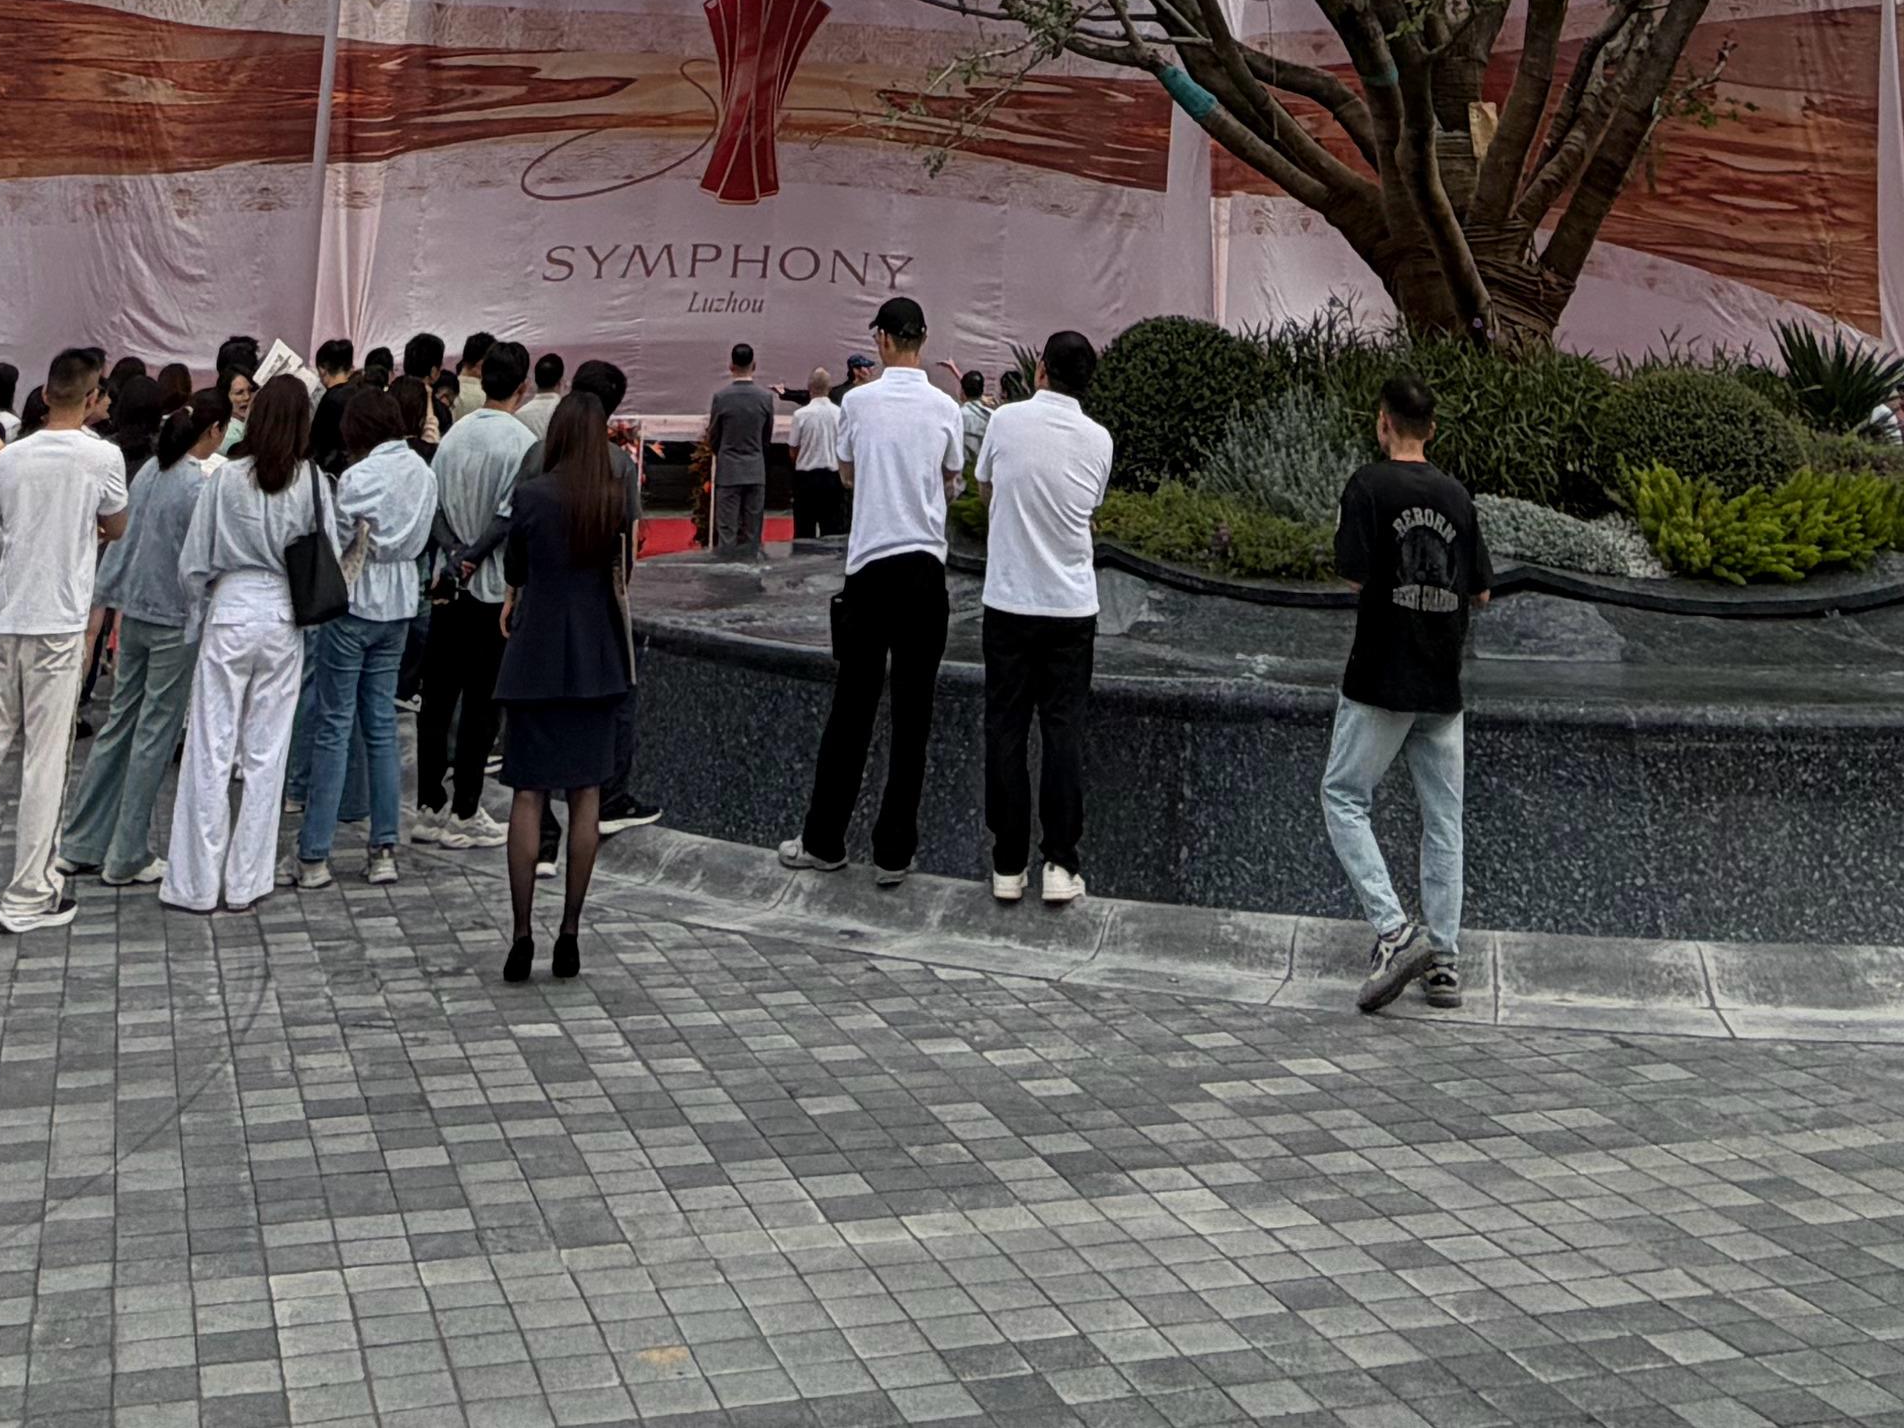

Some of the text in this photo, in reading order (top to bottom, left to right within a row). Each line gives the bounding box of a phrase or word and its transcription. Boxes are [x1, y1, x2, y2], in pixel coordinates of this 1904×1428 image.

[541, 243, 915, 290] SYMPHONY
[686, 290, 766, 314] Luzhou
[1392, 506, 1457, 544] REBORN
